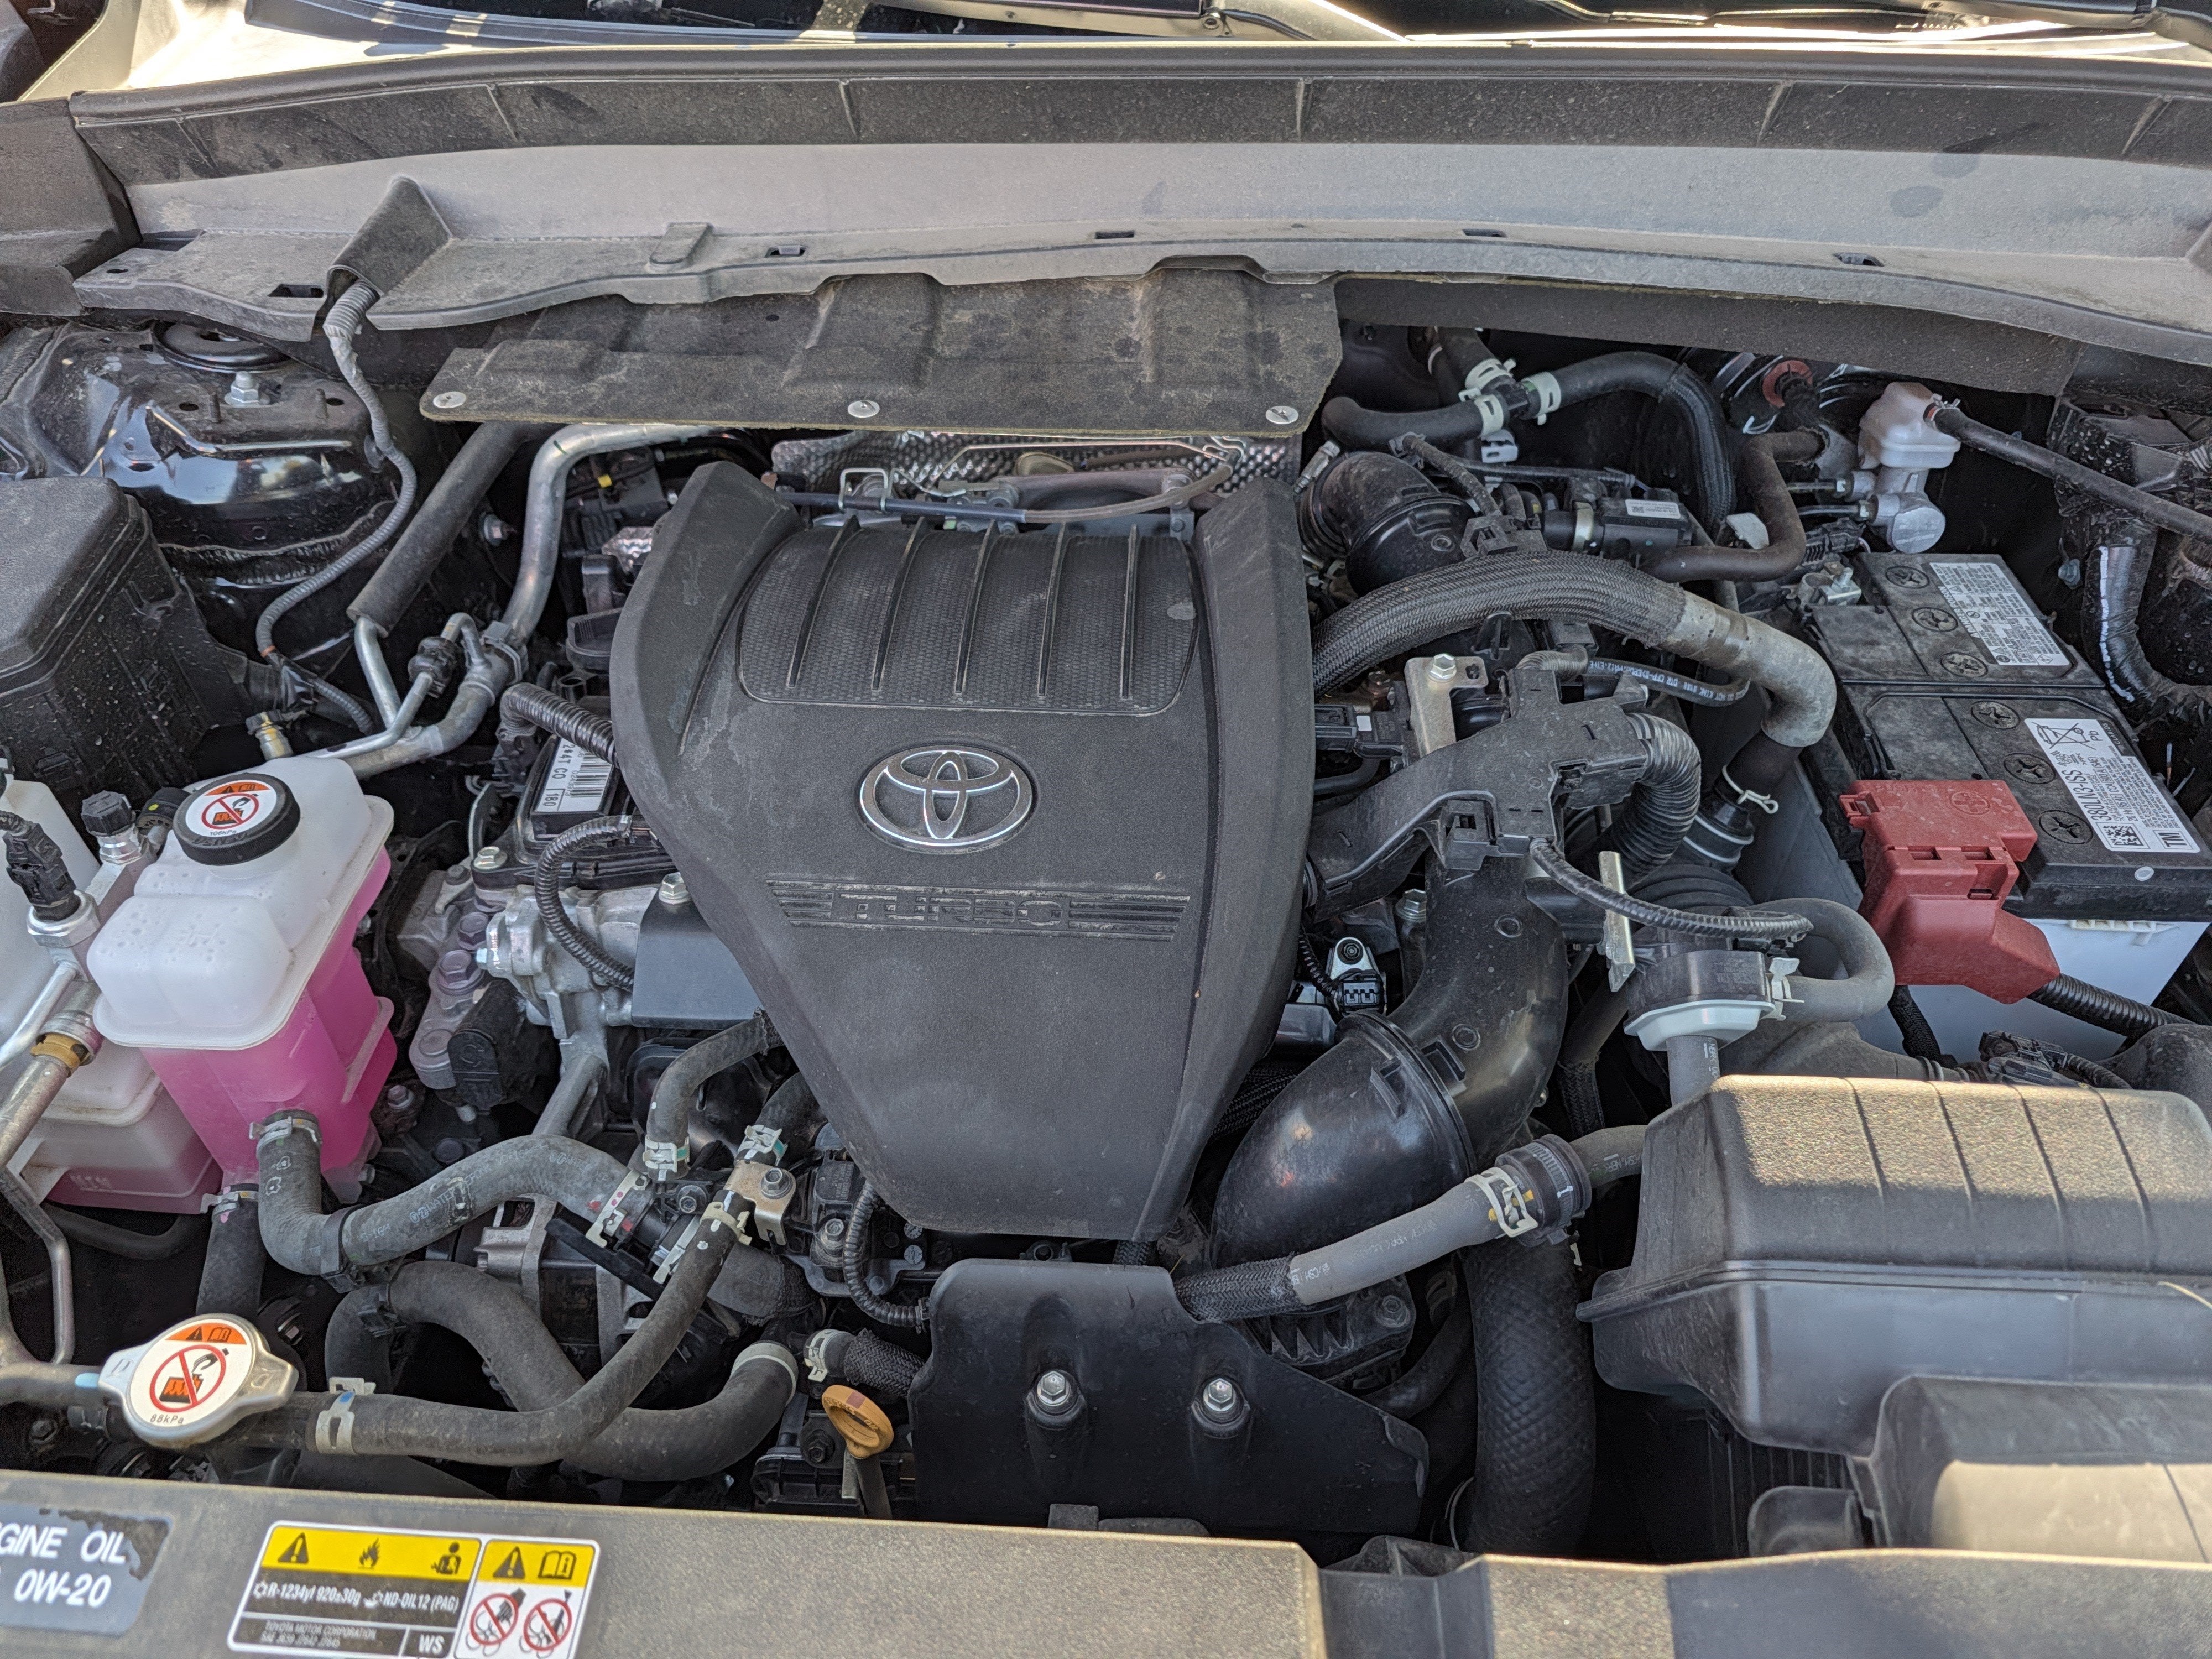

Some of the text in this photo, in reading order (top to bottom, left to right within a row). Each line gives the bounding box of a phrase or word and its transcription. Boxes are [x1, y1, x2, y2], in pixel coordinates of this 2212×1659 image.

[2088, 730, 2103, 742] Pb
[2102, 722, 2120, 746] CLARIOS
[542, 792, 559, 807] 180
[2059, 770, 2113, 821] 380LN3-ISS
[2158, 832, 2187, 847] TM
[839, 893, 1063, 928] TURBO
[149, 1413, 185, 1425] 88kPa
[80, 1530, 127, 1564] OIL
[14, 1568, 112, 1608] 0W-20
[430, 1595, 460, 1615] (PAG)
[418, 1634, 445, 1655] WS
